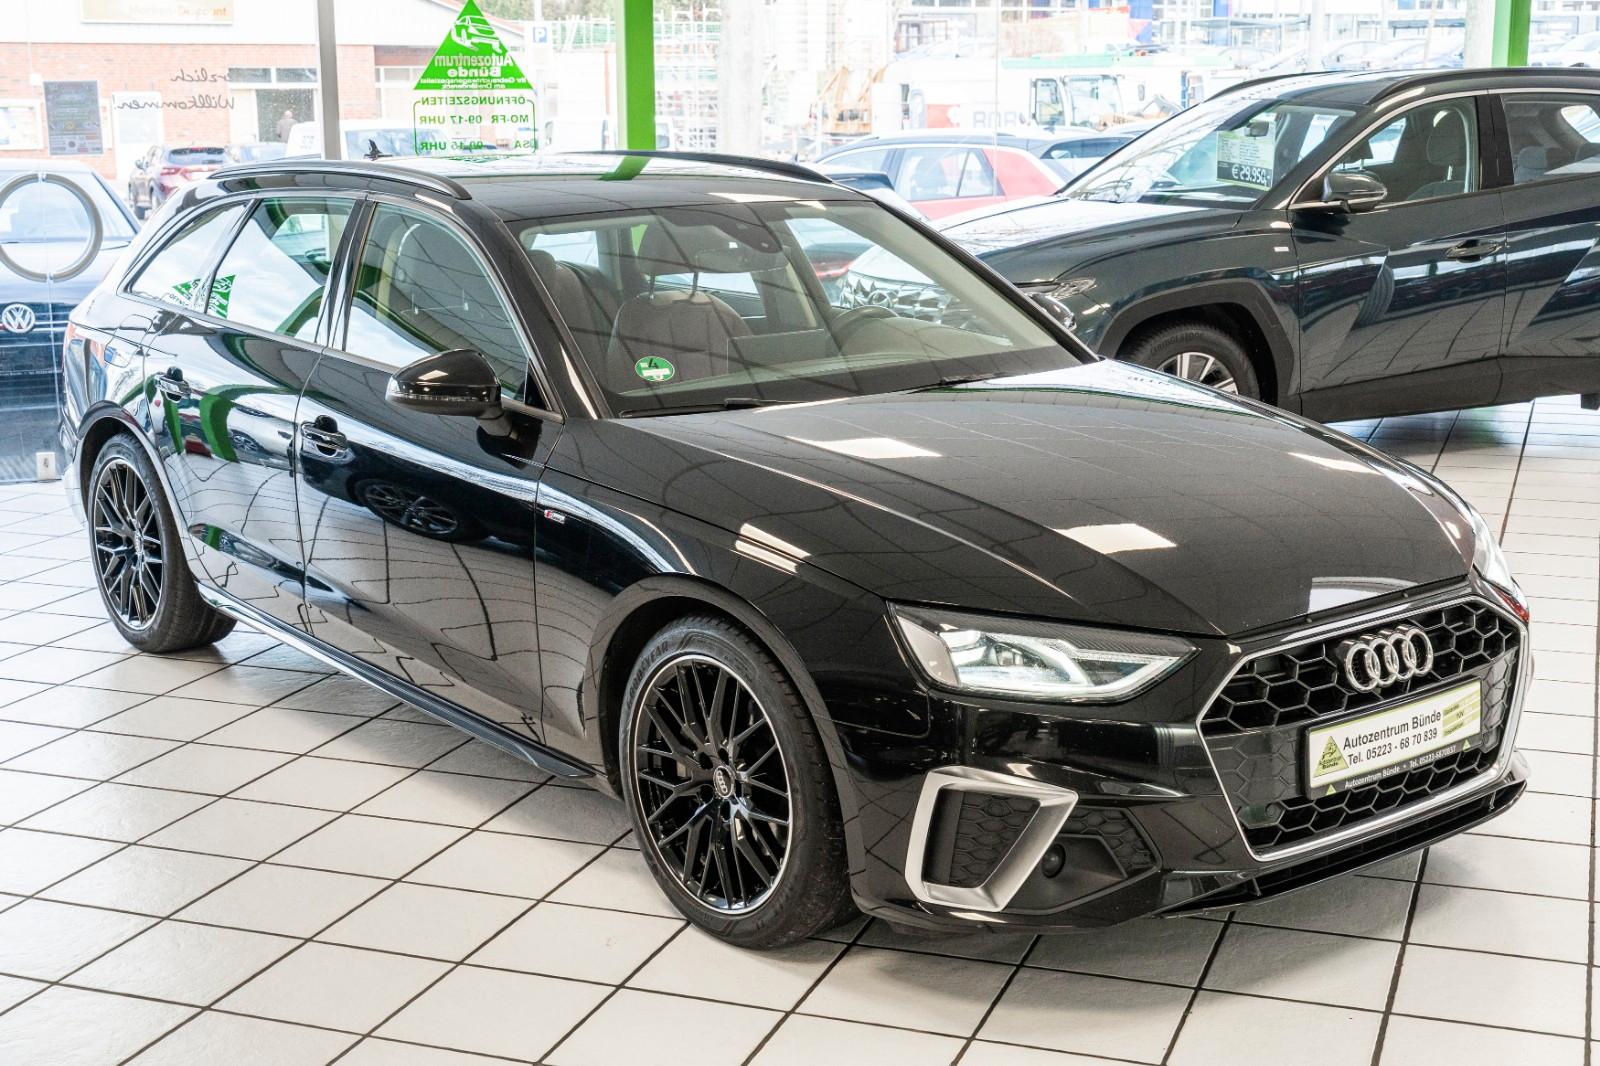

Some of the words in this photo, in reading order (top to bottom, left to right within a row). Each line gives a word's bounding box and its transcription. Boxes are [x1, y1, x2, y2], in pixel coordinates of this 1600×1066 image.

[1343, 722, 1409, 751] Autozentrum
[1411, 710, 1442, 730] Bünde
[1347, 752, 1364, 767] Tel.
[1366, 743, 1392, 760] 05223
[1400, 737, 1410, 750] 68
[1412, 733, 1422, 745] 70
[1423, 728, 1438, 742] 839
[1344, 772, 1382, 789] Autozentrum
[1382, 764, 1400, 778] Bünde
